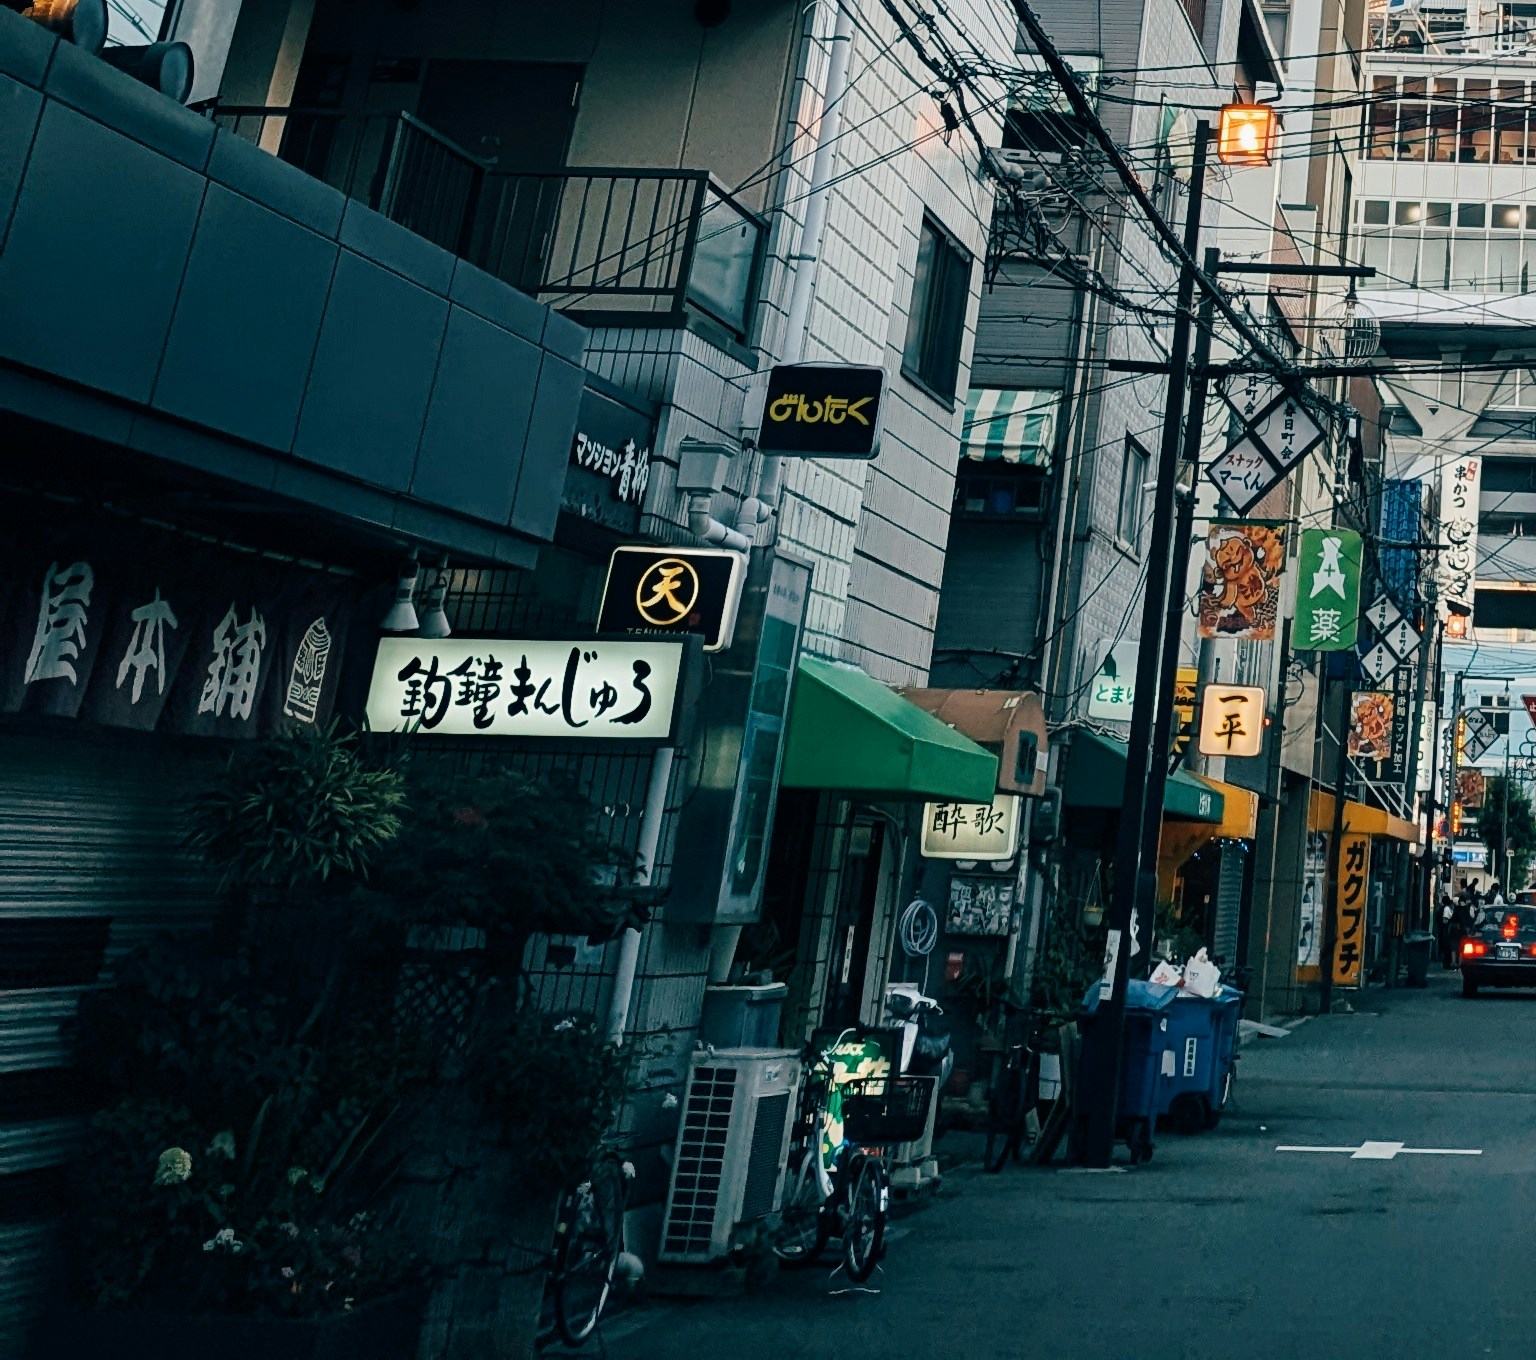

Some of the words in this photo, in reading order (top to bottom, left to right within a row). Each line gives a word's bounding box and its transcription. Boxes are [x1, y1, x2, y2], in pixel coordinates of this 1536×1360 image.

[769, 392, 874, 427] どんたく
[1244, 376, 1257, 415] 日町会
[1281, 402, 1295, 460] 春日町会
[576, 432, 649, 505] マンション青柳
[1219, 470, 1264, 491] マーくん
[1226, 454, 1264, 468] スナック
[1453, 465, 1467, 509] 串かつ
[641, 567, 686, 615] 天
[24, 560, 266, 722] 屋本舗
[1310, 607, 1341, 643] 薬
[398, 648, 652, 730] 釣鐘まんじゅう
[1215, 694, 1249, 750] 一平
[933, 805, 1004, 840] 酔歌
